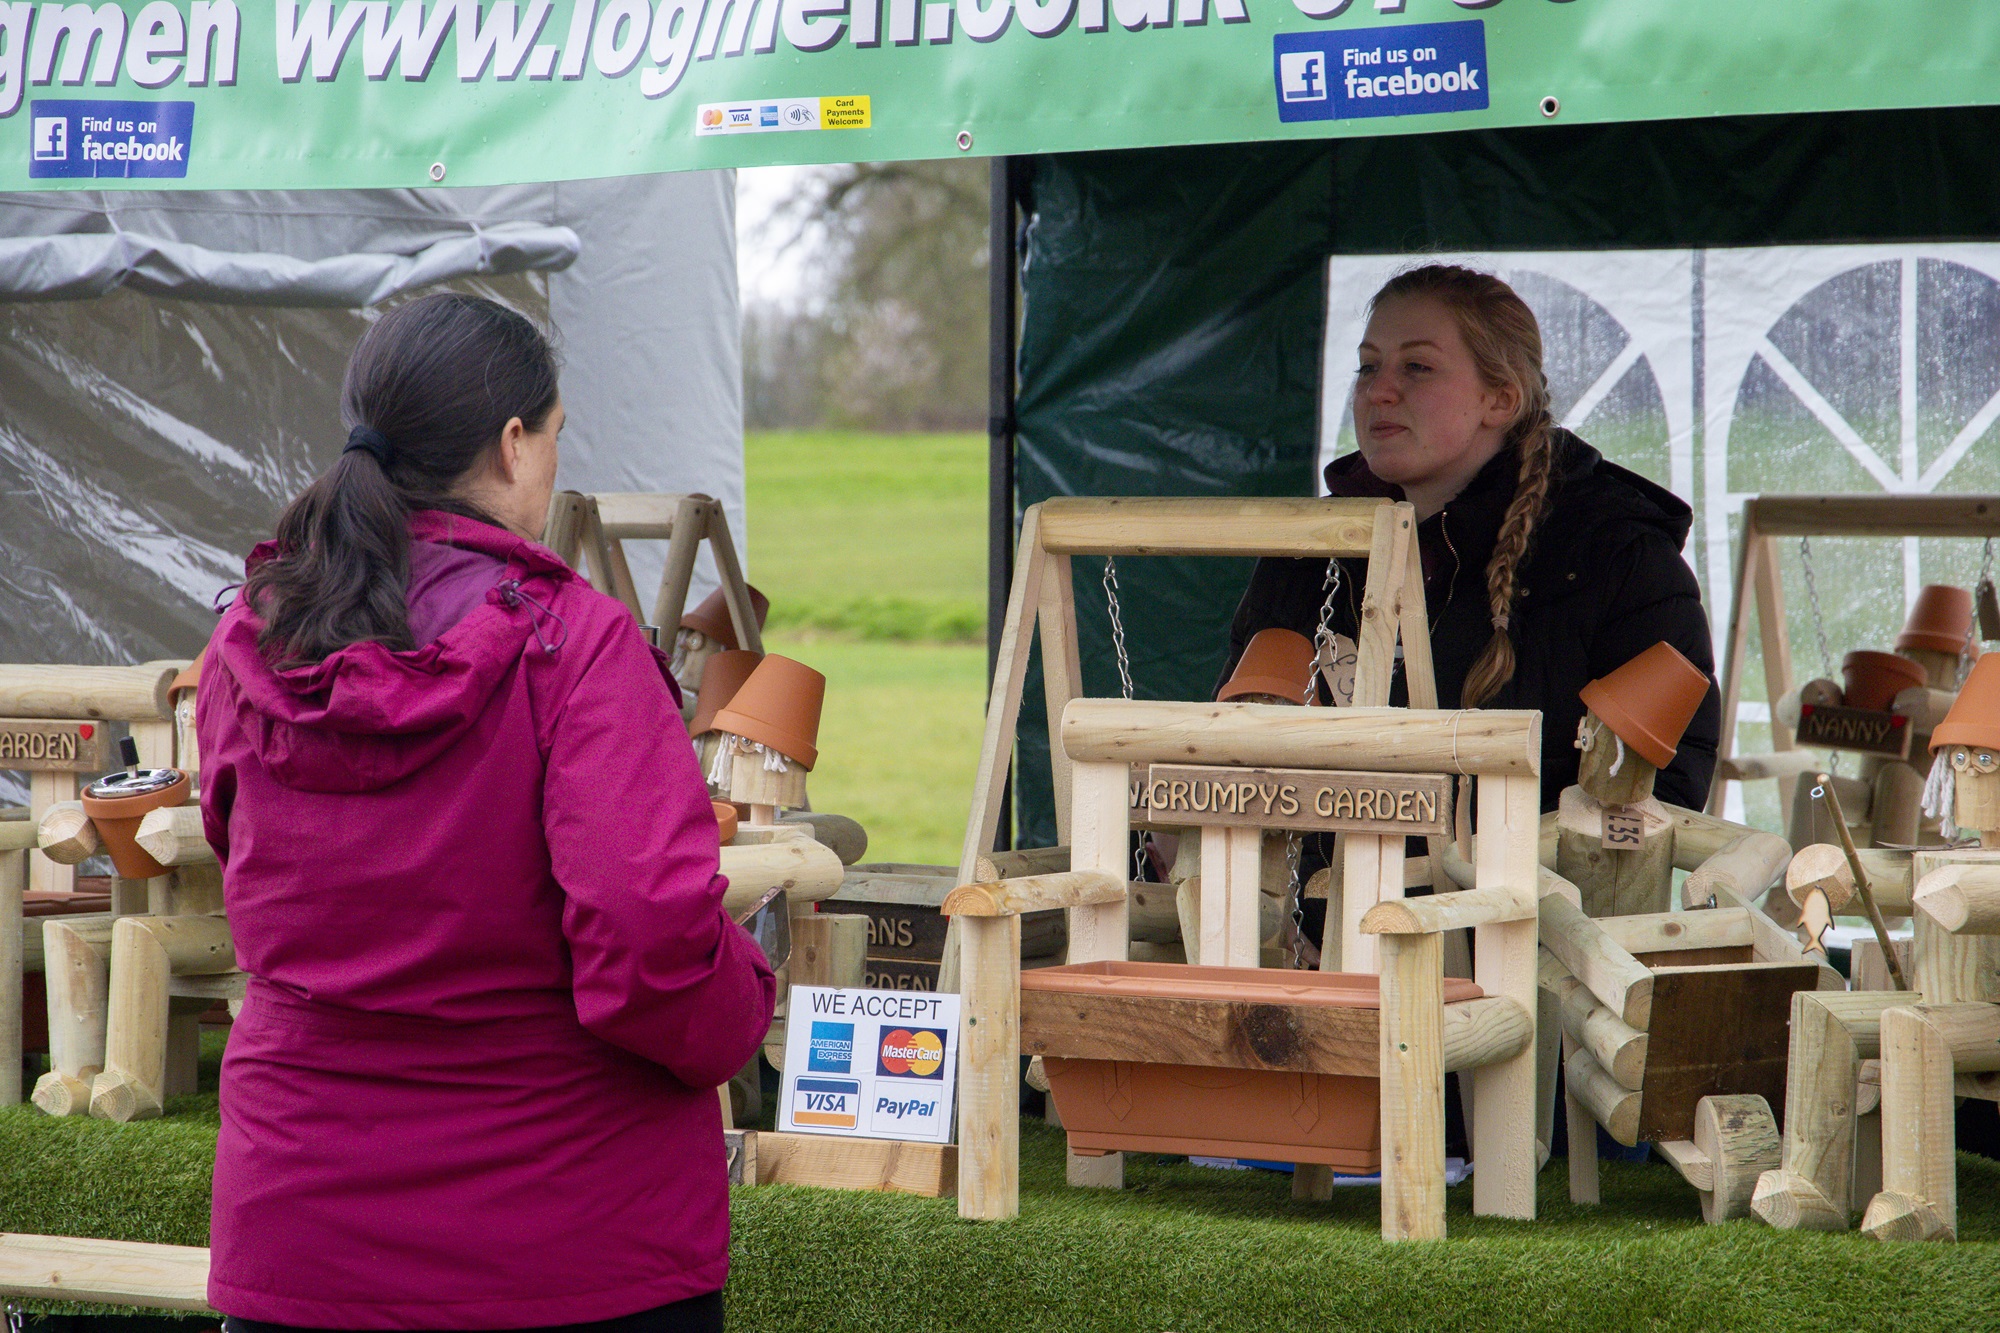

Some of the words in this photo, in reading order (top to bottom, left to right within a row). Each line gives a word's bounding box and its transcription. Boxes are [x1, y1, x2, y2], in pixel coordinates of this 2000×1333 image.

[276, 0, 1248, 98] www.logmen..
[1343, 48, 1381, 66] Find
[1387, 49, 1407, 63] us
[1413, 47, 1437, 61] on
[1345, 62, 1479, 99] facebook
[826, 108, 864, 117] Payments
[835, 99, 854, 107] Card
[81, 117, 112, 132] Find
[116, 119, 133, 132] us
[138, 120, 157, 133] on
[732, 114, 750, 122] VISA
[828, 118, 863, 126] Welcome
[82, 134, 184, 161] facebook
[1808, 714, 1891, 743] NANNY
[1151, 779, 1299, 816] GRUMPYS
[1314, 786, 1437, 823] GARDEN
[812, 992, 846, 1014] WE
[851, 995, 942, 1020] ACCEPT
[810, 1039, 851, 1050] AMERICAN
[882, 1045, 942, 1061] MasterCard
[818, 1050, 852, 1060] EXPRESS
[805, 1093, 846, 1112] VISA
[876, 1097, 936, 1119] PayPal
